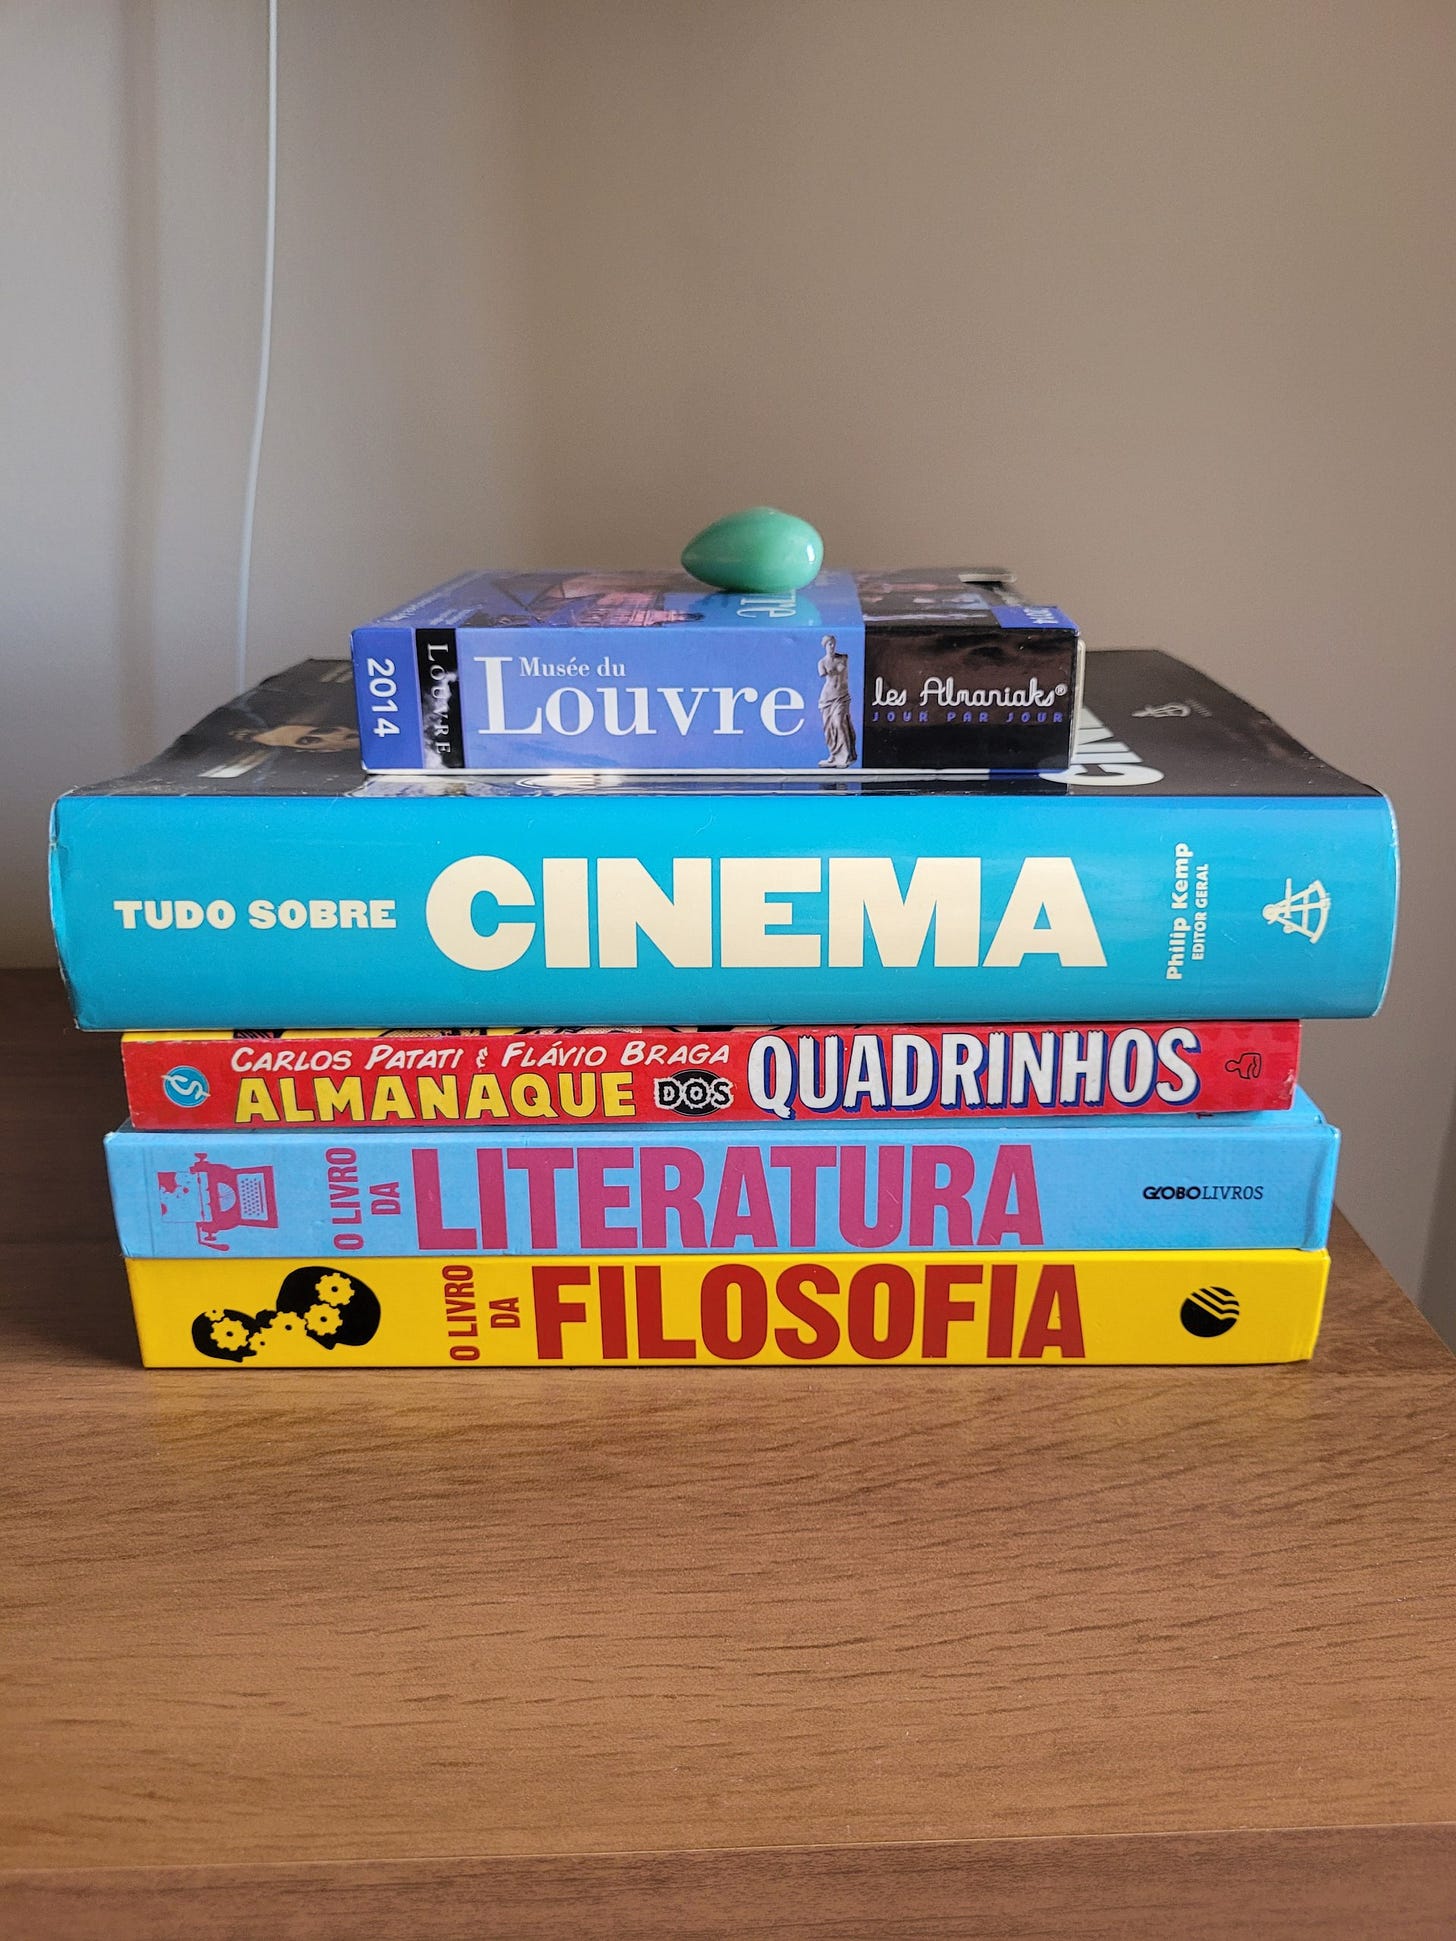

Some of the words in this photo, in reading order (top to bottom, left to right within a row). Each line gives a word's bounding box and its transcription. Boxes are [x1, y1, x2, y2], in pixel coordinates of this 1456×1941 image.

[367, 658, 400, 737] 2014
[474, 656, 805, 736] Louvre
[520, 656, 590, 677] Musée
[596, 656, 626, 677] du
[872, 677, 907, 707] les
[427, 643, 451, 754] LOUVRE
[872, 711, 929, 723] JOUR
[947, 711, 989, 723] PAR
[1006, 711, 1063, 723] JOUR
[1171, 842, 1193, 909] Kemp
[1195, 864, 1209, 907] GERAL
[113, 900, 236, 929] TUDO
[248, 900, 397, 929] SOBRE
[426, 855, 1108, 971] CINEMA
[1191, 912, 1208, 960] EDITOR
[1166, 917, 1191, 980] Philip
[231, 1047, 353, 1072] CARLOS
[364, 1044, 464, 1070] PATATI
[475, 1046, 490, 1071] &
[501, 1039, 607, 1068] FLÁVIO
[620, 1040, 730, 1066] BRAGA
[235, 1072, 637, 1123] ALMANAQUE
[653, 1076, 736, 1110] DOS
[747, 1027, 1201, 1121] QUADRINHOS
[325, 1147, 363, 1225] LIVRO
[371, 1181, 400, 1215] DA
[411, 1144, 1044, 1250] LITERATURA
[334, 1233, 364, 1250] O
[442, 1264, 480, 1337] LIVRO
[490, 1296, 521, 1328] DA
[531, 1263, 1086, 1361] FILOSOFIA
[449, 1345, 480, 1361] O
